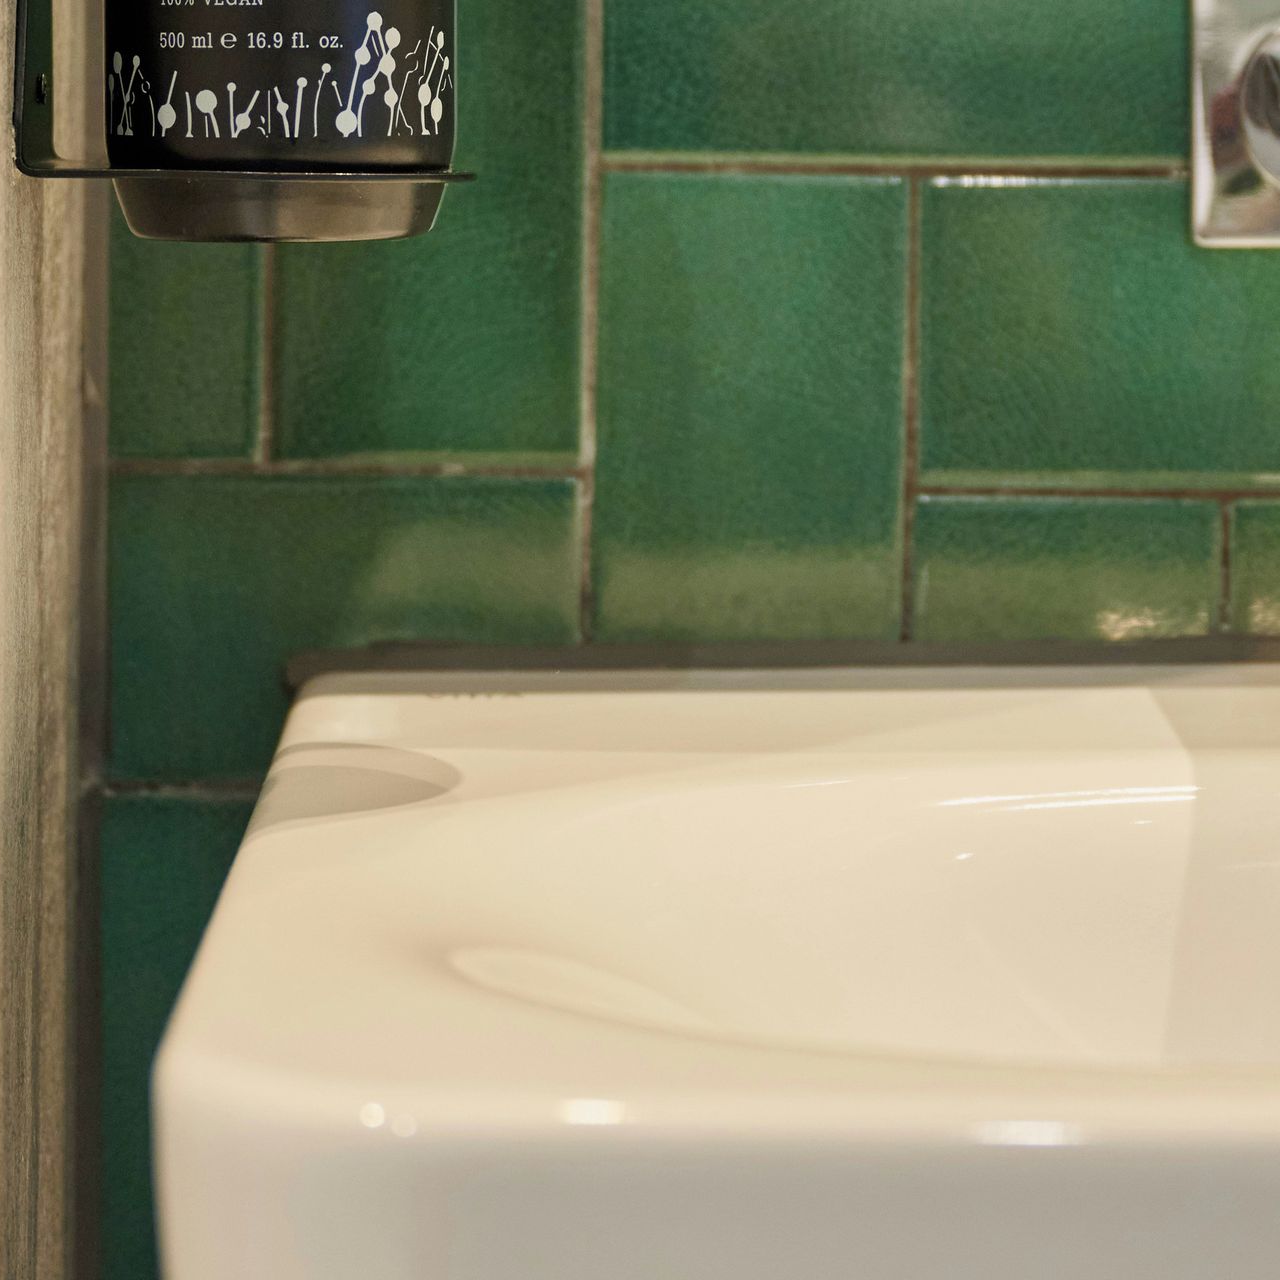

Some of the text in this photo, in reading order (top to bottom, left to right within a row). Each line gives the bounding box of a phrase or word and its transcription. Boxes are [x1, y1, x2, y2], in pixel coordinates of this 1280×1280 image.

[159, 31, 185, 49] 500
[191, 31, 214, 49] ml
[247, 31, 283, 49] 16.9
[291, 31, 310, 49] fl.
[317, 34, 344, 49] oz.
